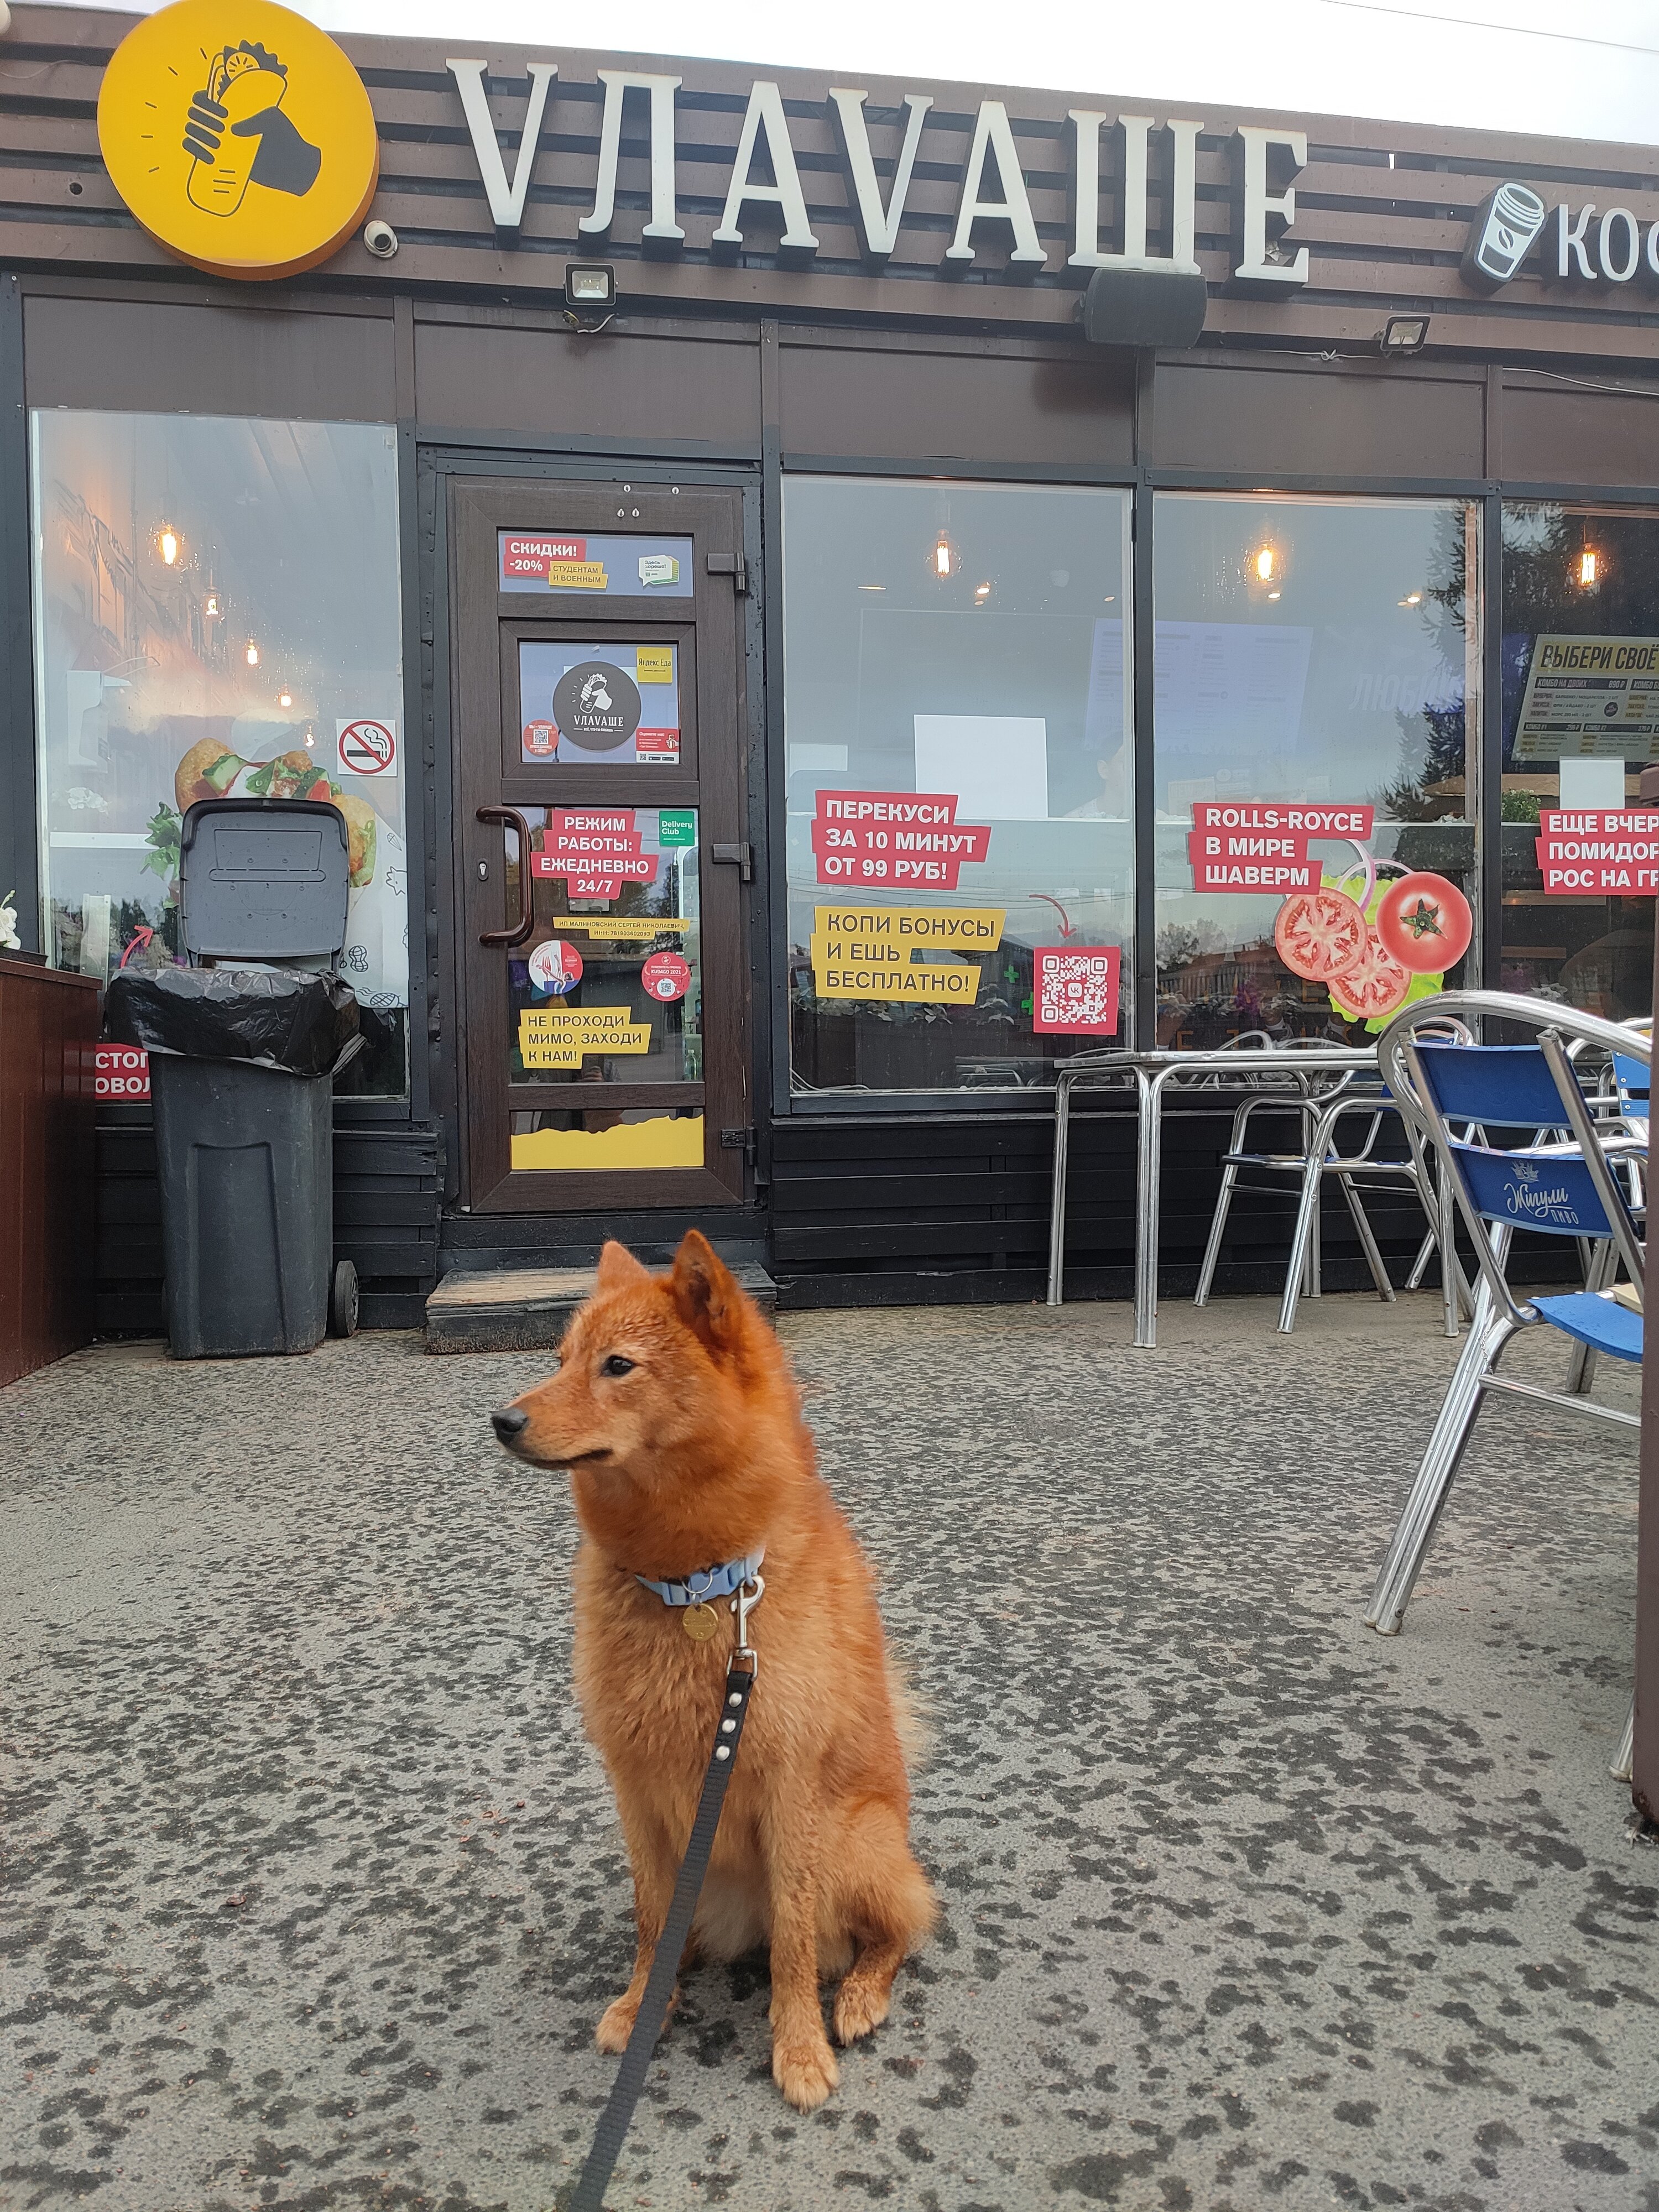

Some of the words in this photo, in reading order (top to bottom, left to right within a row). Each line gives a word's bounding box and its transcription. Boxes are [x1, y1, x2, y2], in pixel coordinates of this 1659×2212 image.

[510, 542, 578, 557] СКИДКИ!
[509, 560, 543, 572] -20%
[553, 565, 599, 574] СТУДЕНТАМ
[553, 574, 559, 582] И
[561, 575, 602, 583] ВОЕННЫМ
[638, 658, 659, 667] Яндекс
[660, 658, 671, 667] Еда
[1540, 644, 1614, 669] ВЫБЕРИ
[1615, 644, 1659, 670] СВОЁ
[1537, 679, 1558, 687] КОМБО
[1558, 679, 1567, 687] НА
[1567, 680, 1588, 688] ДВОИХ
[1608, 680, 1620, 688] 890
[826, 800, 950, 824] ПЕРЕКУСИ
[1206, 808, 1364, 832] ROLLS-ROYCE
[564, 816, 626, 832] РЕЖИМ
[661, 820, 693, 831] Delivery
[661, 828, 680, 836] Club
[1549, 815, 1598, 835] ЕЩЕ
[557, 837, 633, 853] РАБОТЫ:
[825, 828, 857, 848] ЗА
[864, 831, 887, 849] 10
[895, 832, 977, 854] МИНУТ
[1206, 837, 1222, 855] В
[1228, 838, 1295, 858] МИРЕ
[540, 858, 649, 875] ЕЖЕДНЕВНО
[825, 857, 855, 876] ОТ
[862, 858, 887, 878] 99
[894, 860, 948, 880] РУБ!
[1206, 865, 1310, 886] ШАВЕРМ
[1550, 869, 1594, 888] РОС
[1601, 869, 1631, 887] НА
[577, 879, 613, 895] 24/7
[828, 914, 891, 934] КОПИ
[899, 917, 995, 938] БОНУСЫ
[827, 941, 842, 959] И
[850, 943, 901, 962] ЕШЬ
[826, 970, 969, 993] БЕСПЛАТНО!
[528, 1016, 547, 1027] НЕ
[551, 1015, 625, 1029] ПРОХОДИ
[528, 1033, 577, 1046] МИМО,
[581, 1033, 643, 1046] ЗАХОДИ
[529, 1051, 538, 1062] К
[542, 1051, 578, 1062] НАМ!
[1504, 1183, 1573, 1218] Жигули
